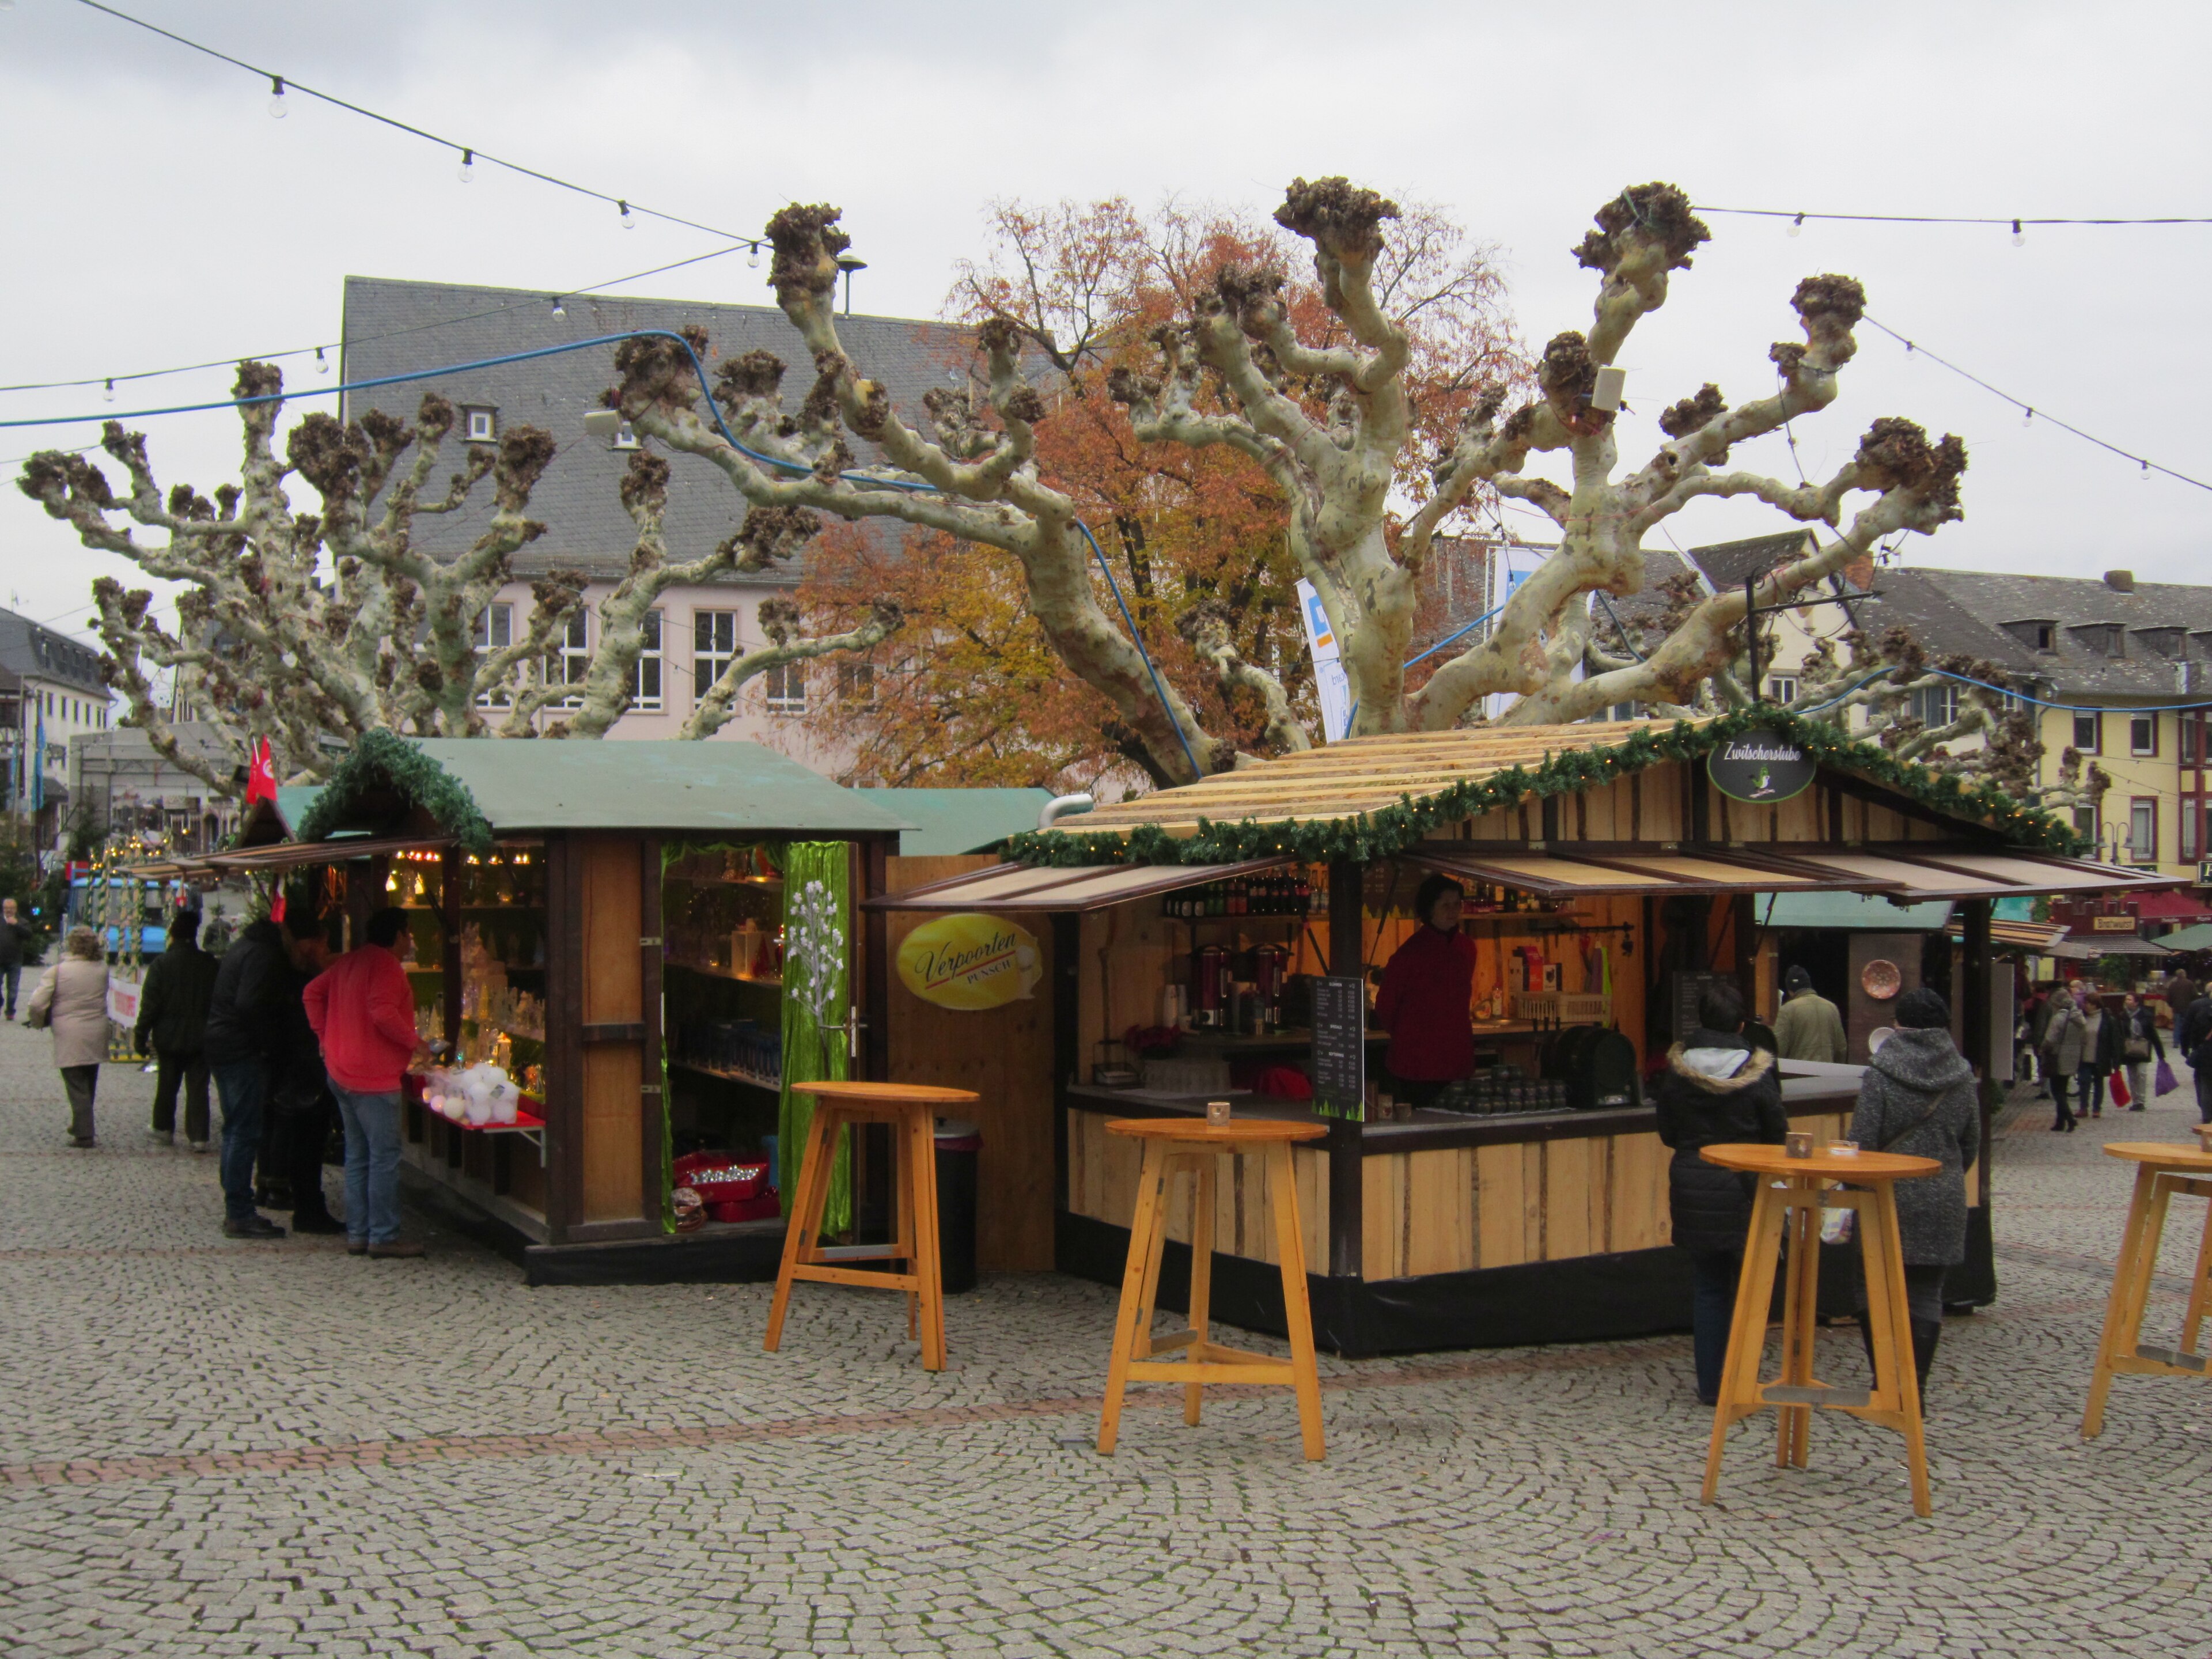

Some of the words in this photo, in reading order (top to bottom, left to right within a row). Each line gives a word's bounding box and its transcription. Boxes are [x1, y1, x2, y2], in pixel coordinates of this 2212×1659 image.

[1723, 741, 1802, 762] Zwitscherstube
[2097, 918, 2133, 929] Bratwurst
[915, 931, 1016, 982] Verpoorten
[967, 960, 1011, 984] PUNSCH
